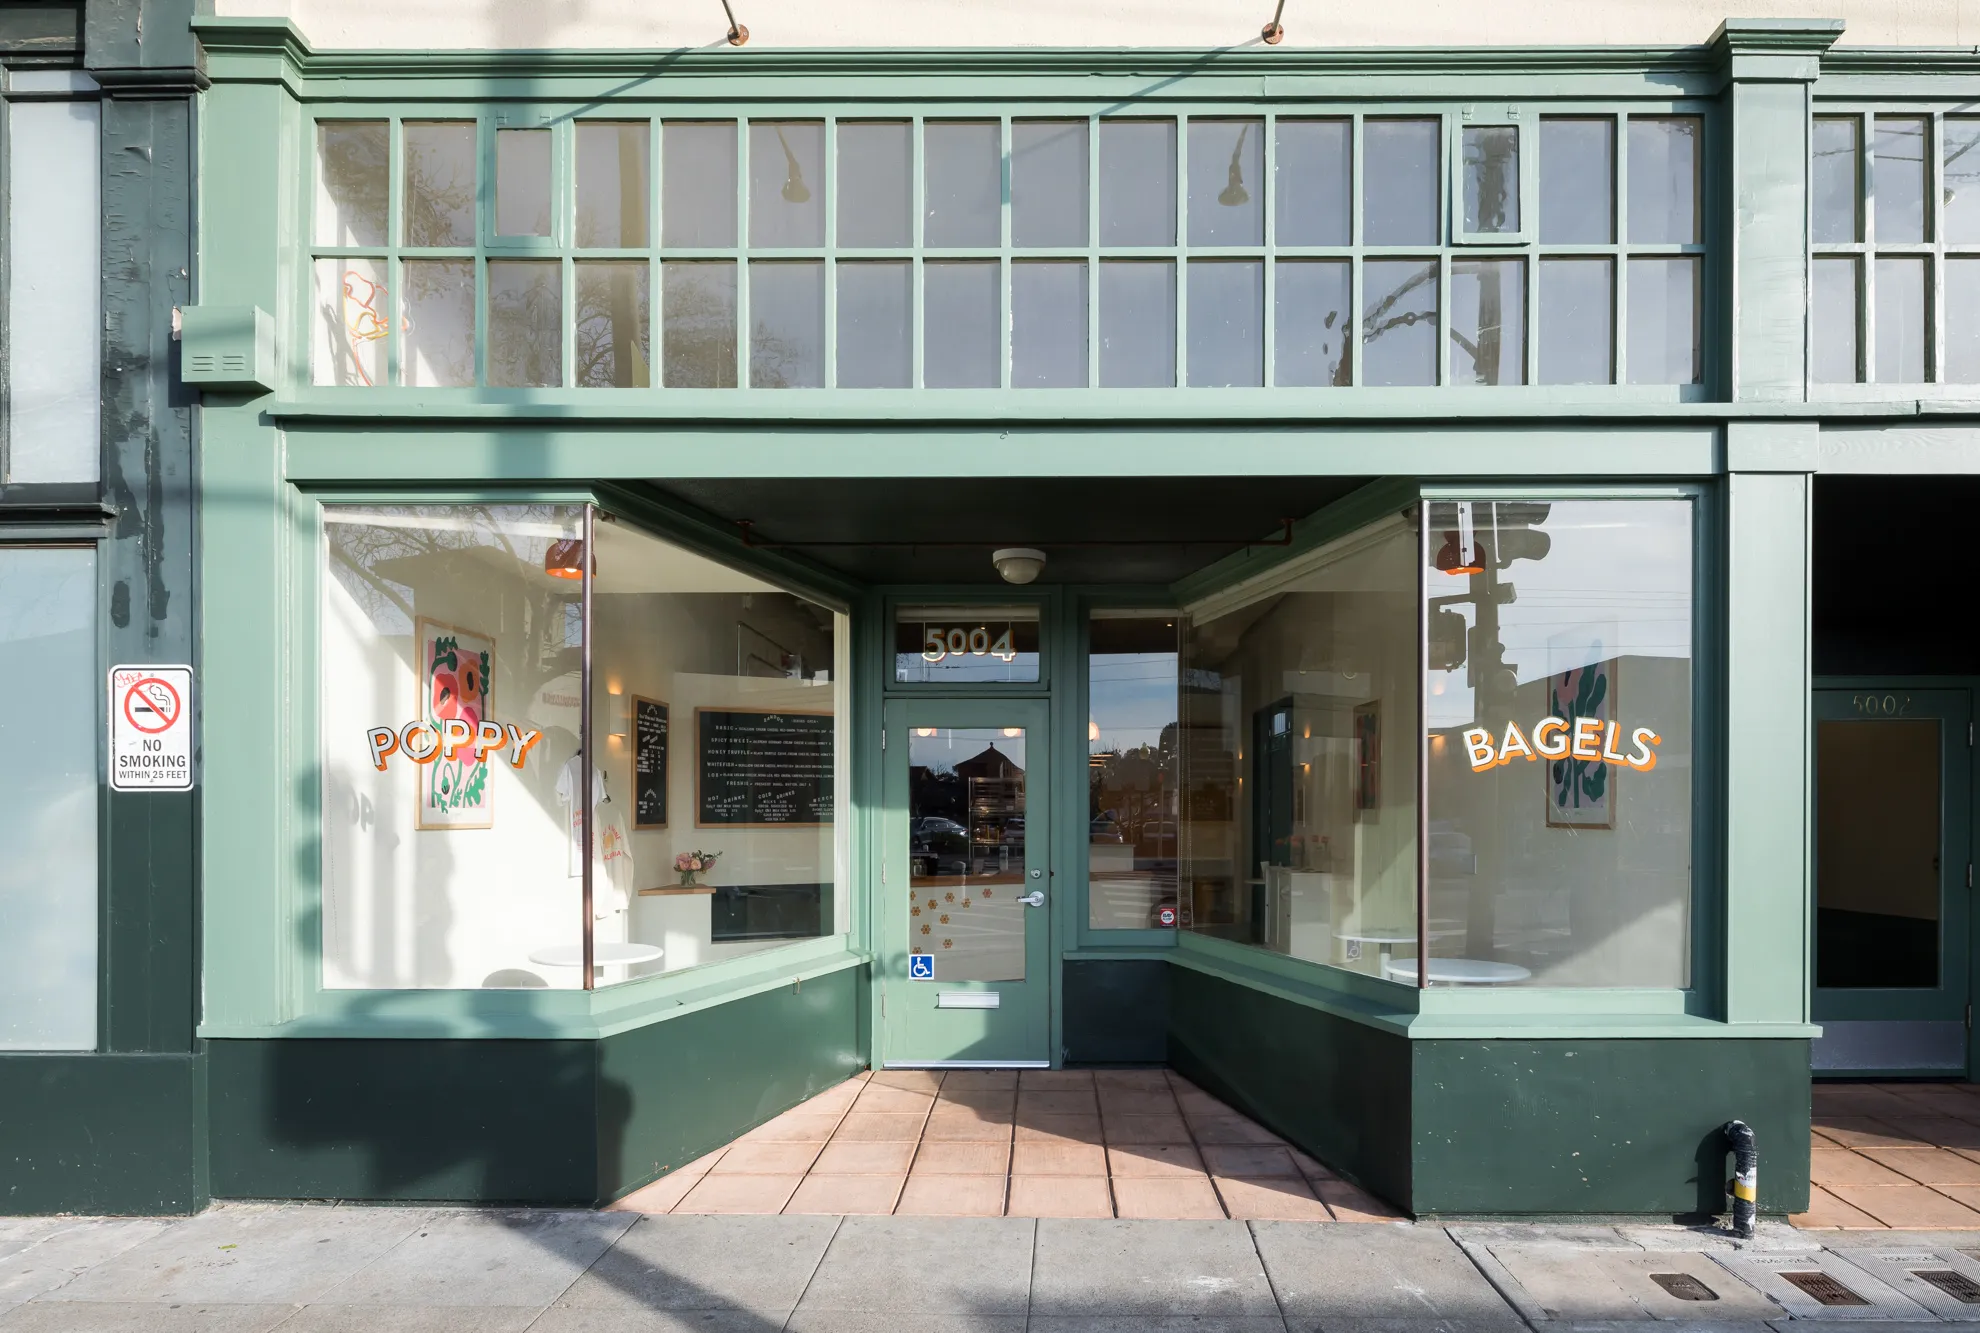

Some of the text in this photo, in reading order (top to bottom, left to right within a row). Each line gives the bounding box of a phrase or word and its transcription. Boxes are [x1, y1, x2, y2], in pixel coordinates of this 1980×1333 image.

[921, 628, 1017, 662] 5004
[142, 739, 162, 752] NO
[367, 719, 544, 771] POPPY
[1462, 716, 1662, 772] BAGELS
[119, 755, 187, 768] SMOKING
[118, 770, 188, 779] WITHIN 25 FEET
[723, 794, 745, 803] DRINKS
